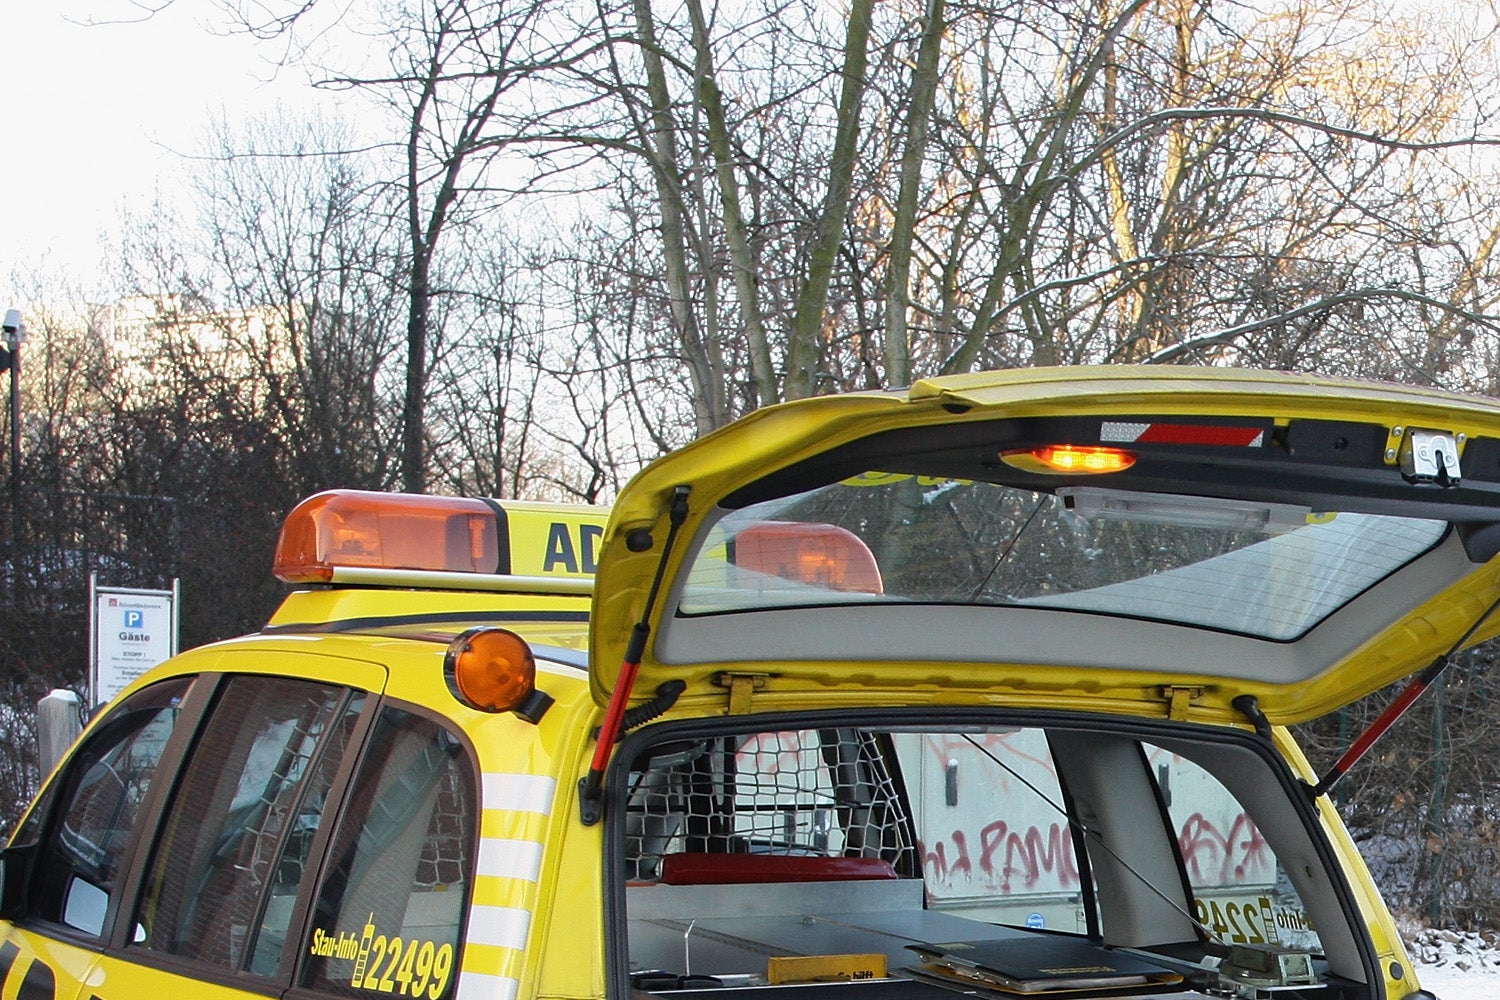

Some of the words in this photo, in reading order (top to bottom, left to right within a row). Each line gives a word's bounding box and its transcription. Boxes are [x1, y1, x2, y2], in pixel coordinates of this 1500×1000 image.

[543, 522, 604, 575] AD
[118, 631, 151, 642] Gäste
[311, 927, 359, 960] Stau-Info
[363, 935, 453, 1000] 22499
